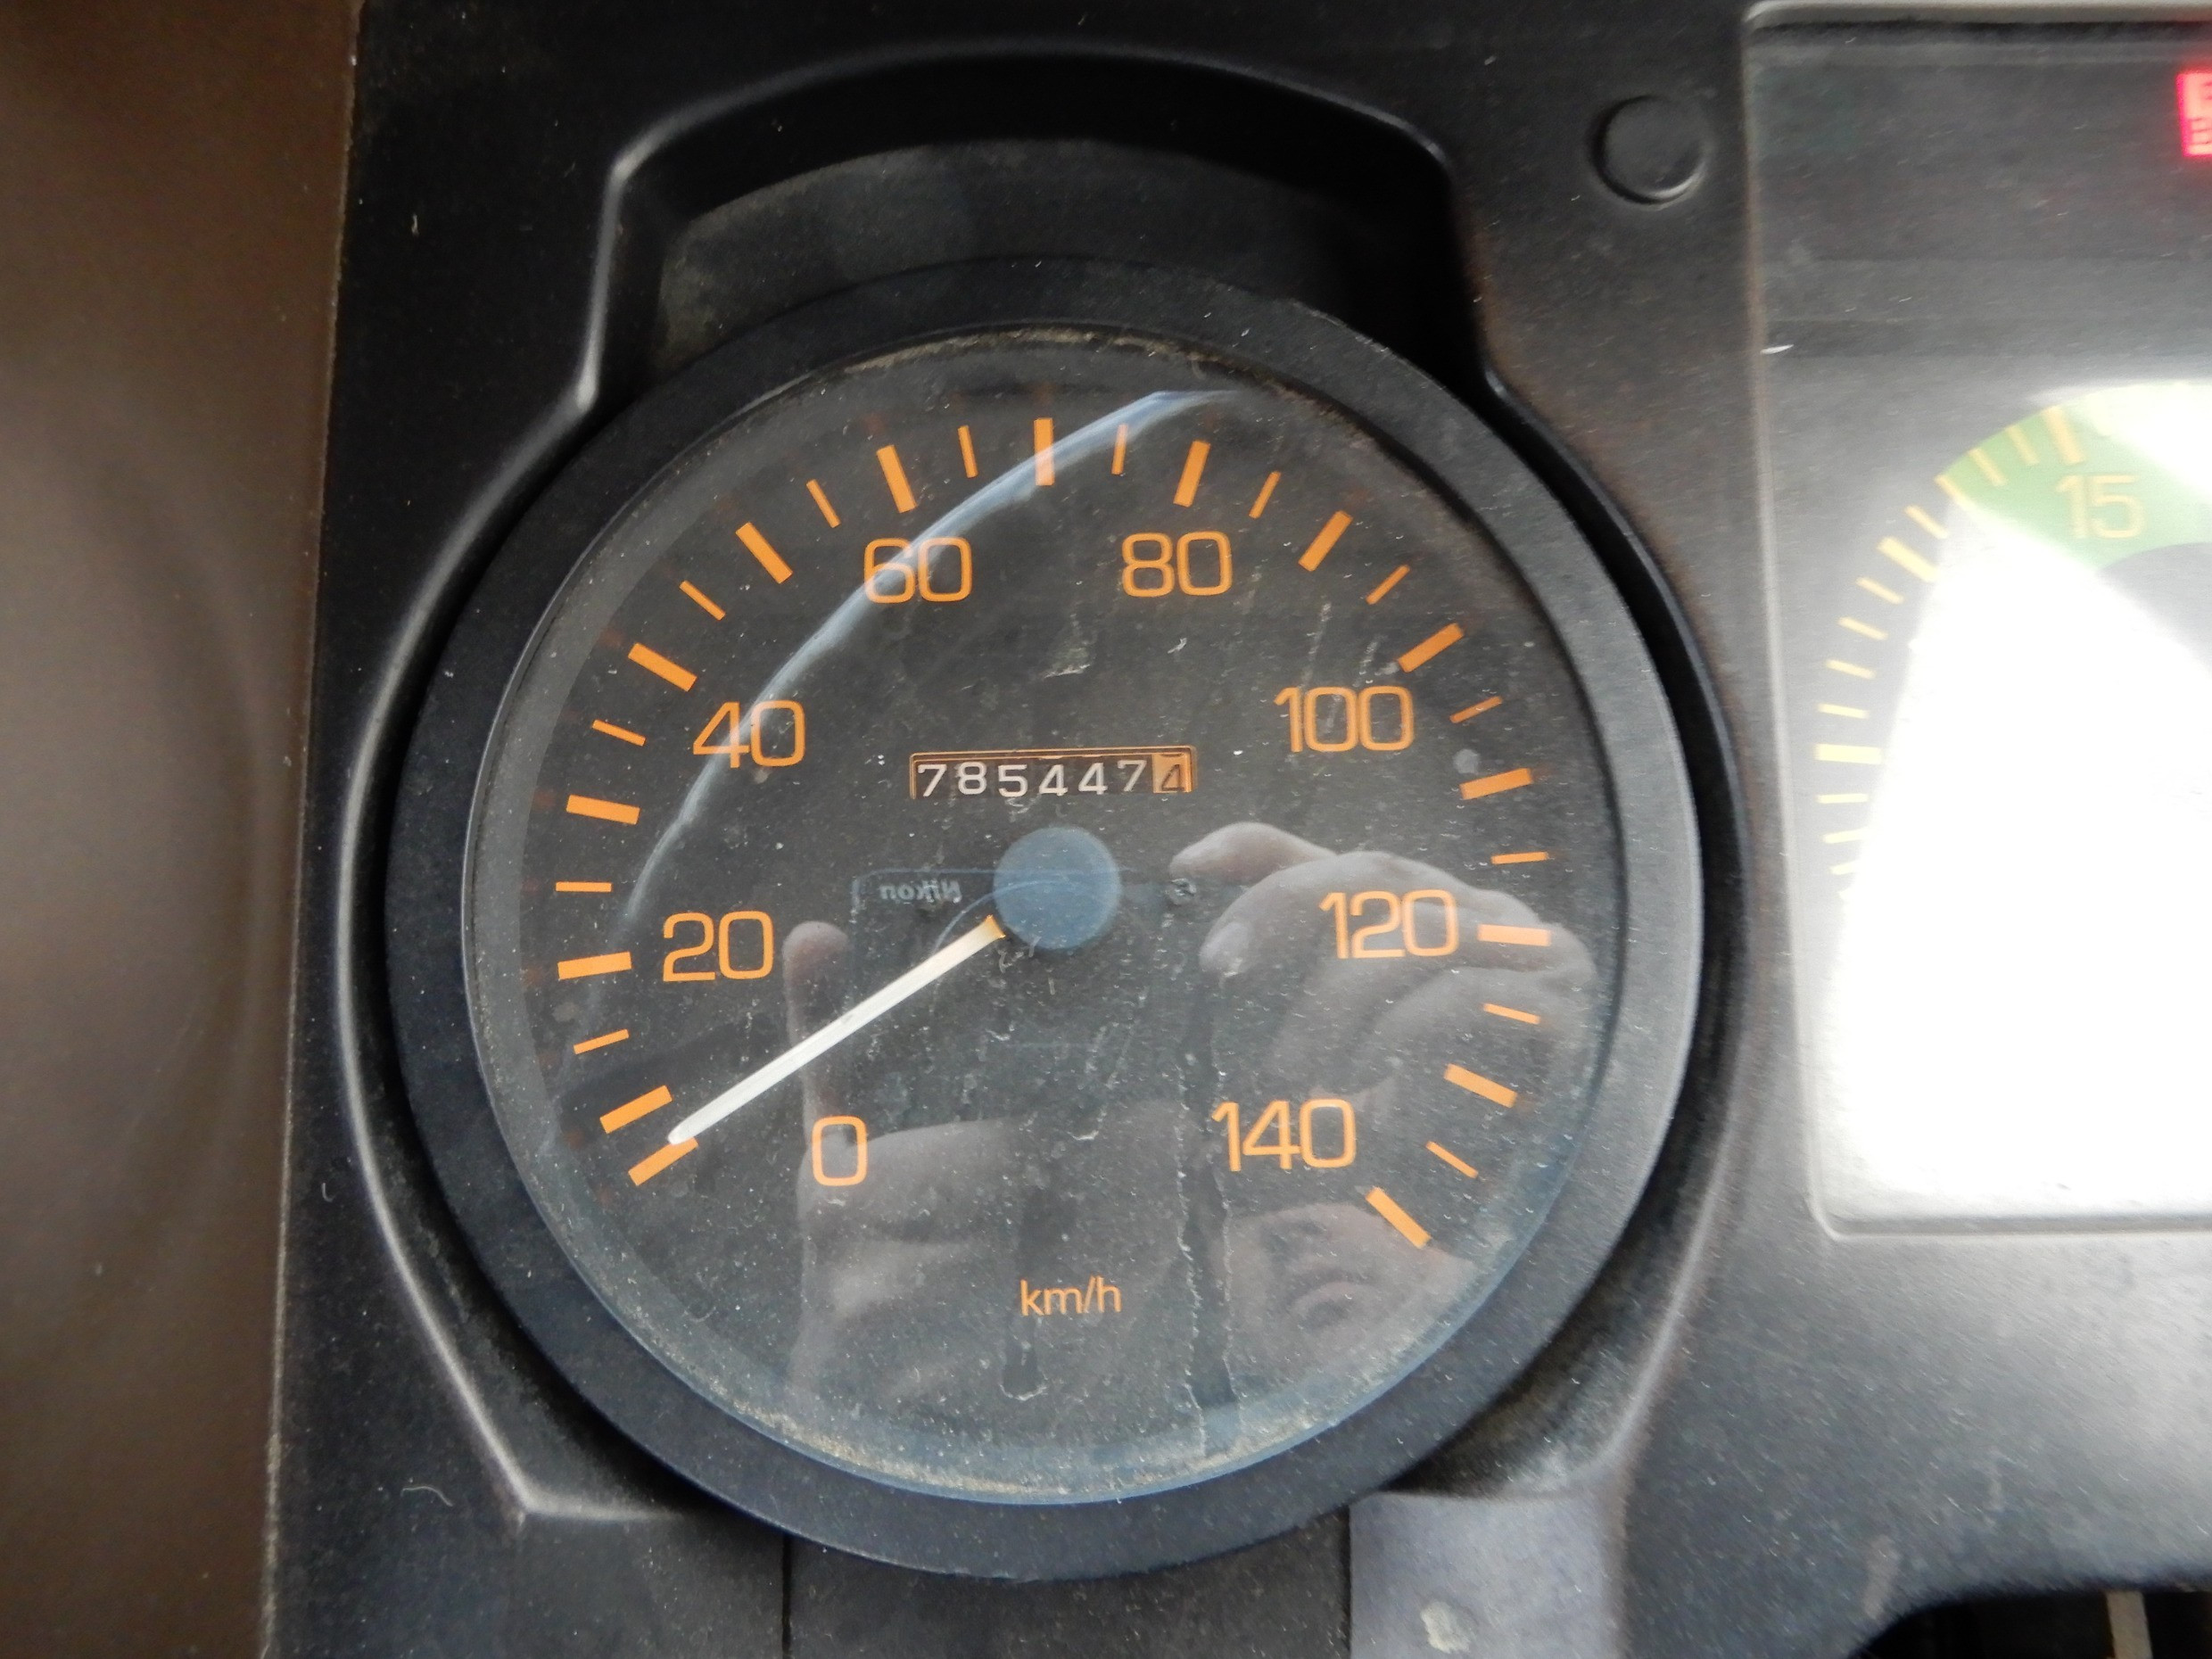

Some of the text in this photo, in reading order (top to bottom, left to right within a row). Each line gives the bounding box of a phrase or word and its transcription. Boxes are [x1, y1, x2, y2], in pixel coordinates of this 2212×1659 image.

[2056, 475, 2146, 538] 15
[863, 537, 972, 603] 60
[1122, 531, 1233, 597] 80
[692, 699, 805, 768] 40
[1274, 685, 1415, 753] 100
[663, 911, 774, 982] 20
[1319, 889, 1459, 959] 120
[812, 1115, 868, 1186] 0
[1211, 1098, 1357, 1172] 140
[1020, 1275, 1122, 1316] km/h
